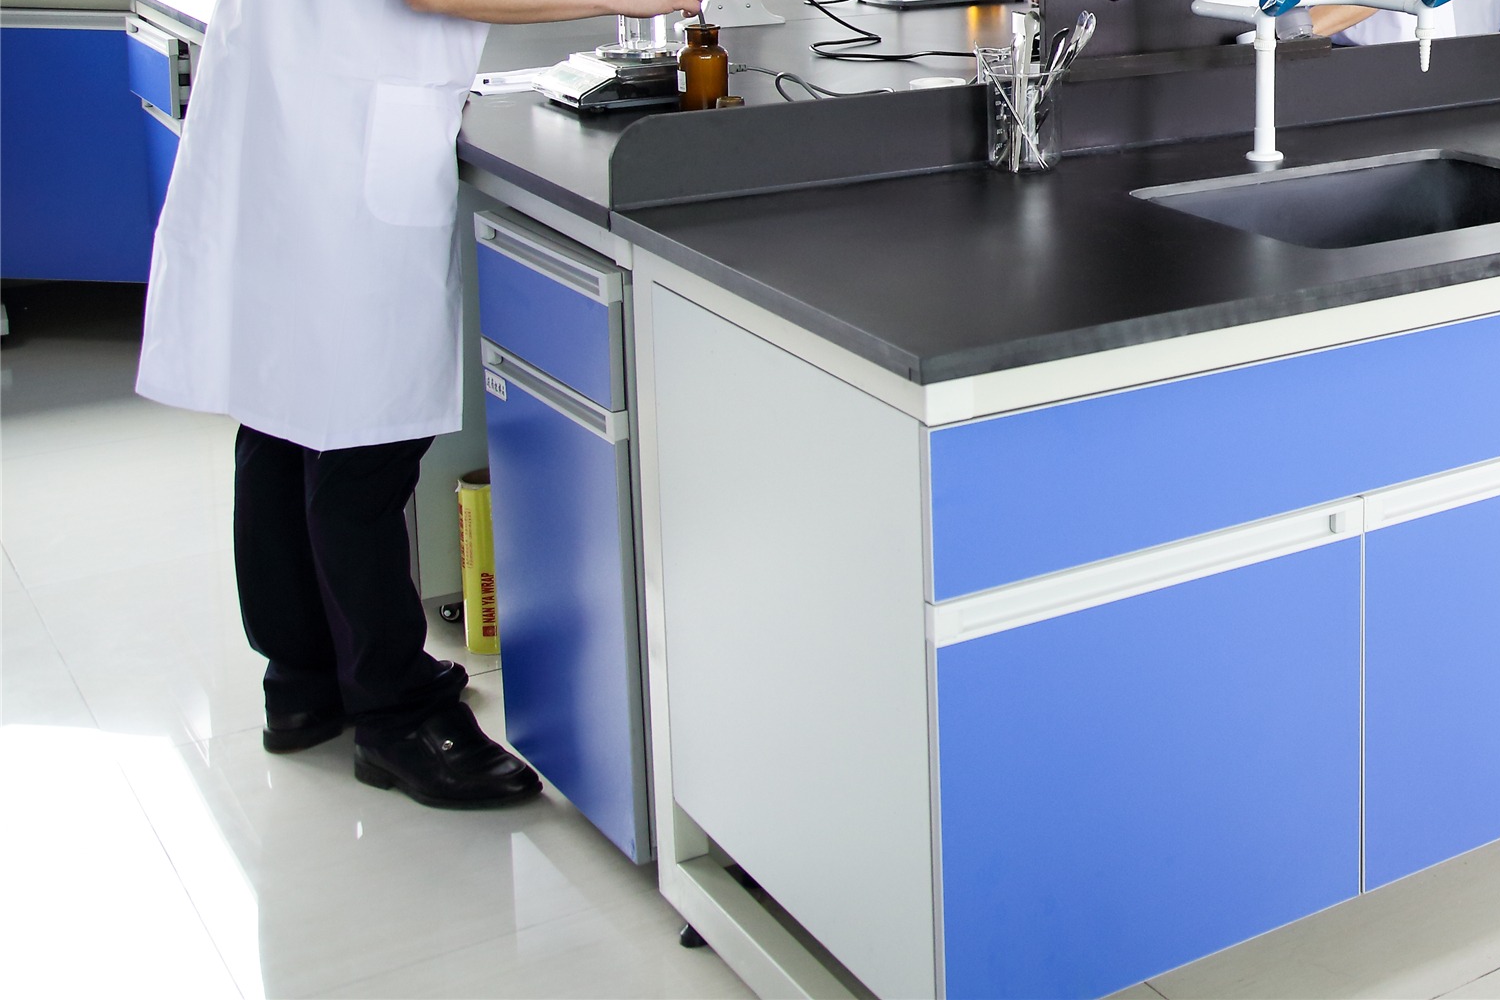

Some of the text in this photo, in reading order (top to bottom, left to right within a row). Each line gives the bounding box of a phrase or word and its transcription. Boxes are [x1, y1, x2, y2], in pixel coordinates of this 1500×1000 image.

[481, 573, 495, 623] NAN YA WRAP
